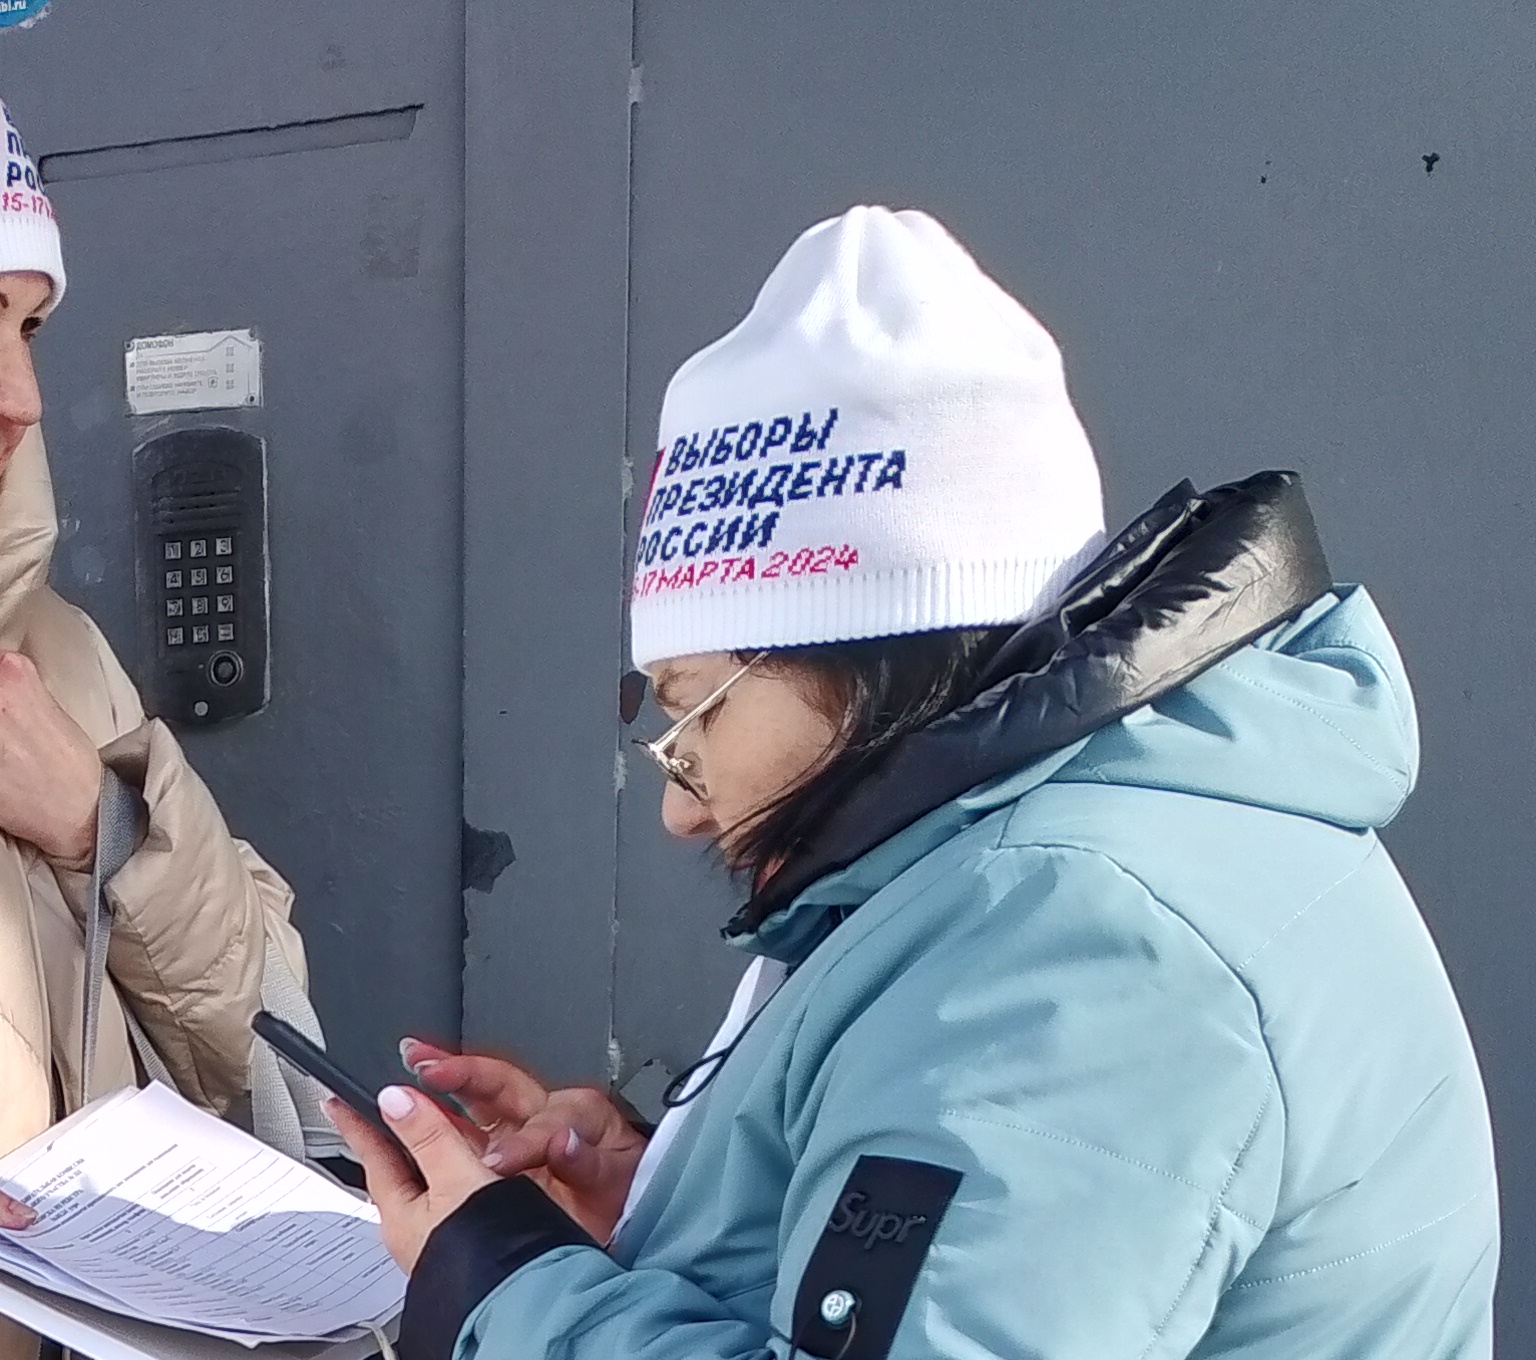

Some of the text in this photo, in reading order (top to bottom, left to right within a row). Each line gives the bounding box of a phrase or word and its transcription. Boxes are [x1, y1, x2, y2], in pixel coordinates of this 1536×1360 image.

[665, 407, 838, 478] ВЫБОРЫ
[645, 449, 907, 526] ПРЕЗИДЕНТА
[656, 544, 859, 593] МАРТА 2024
[828, 1191, 927, 1250] Supr
